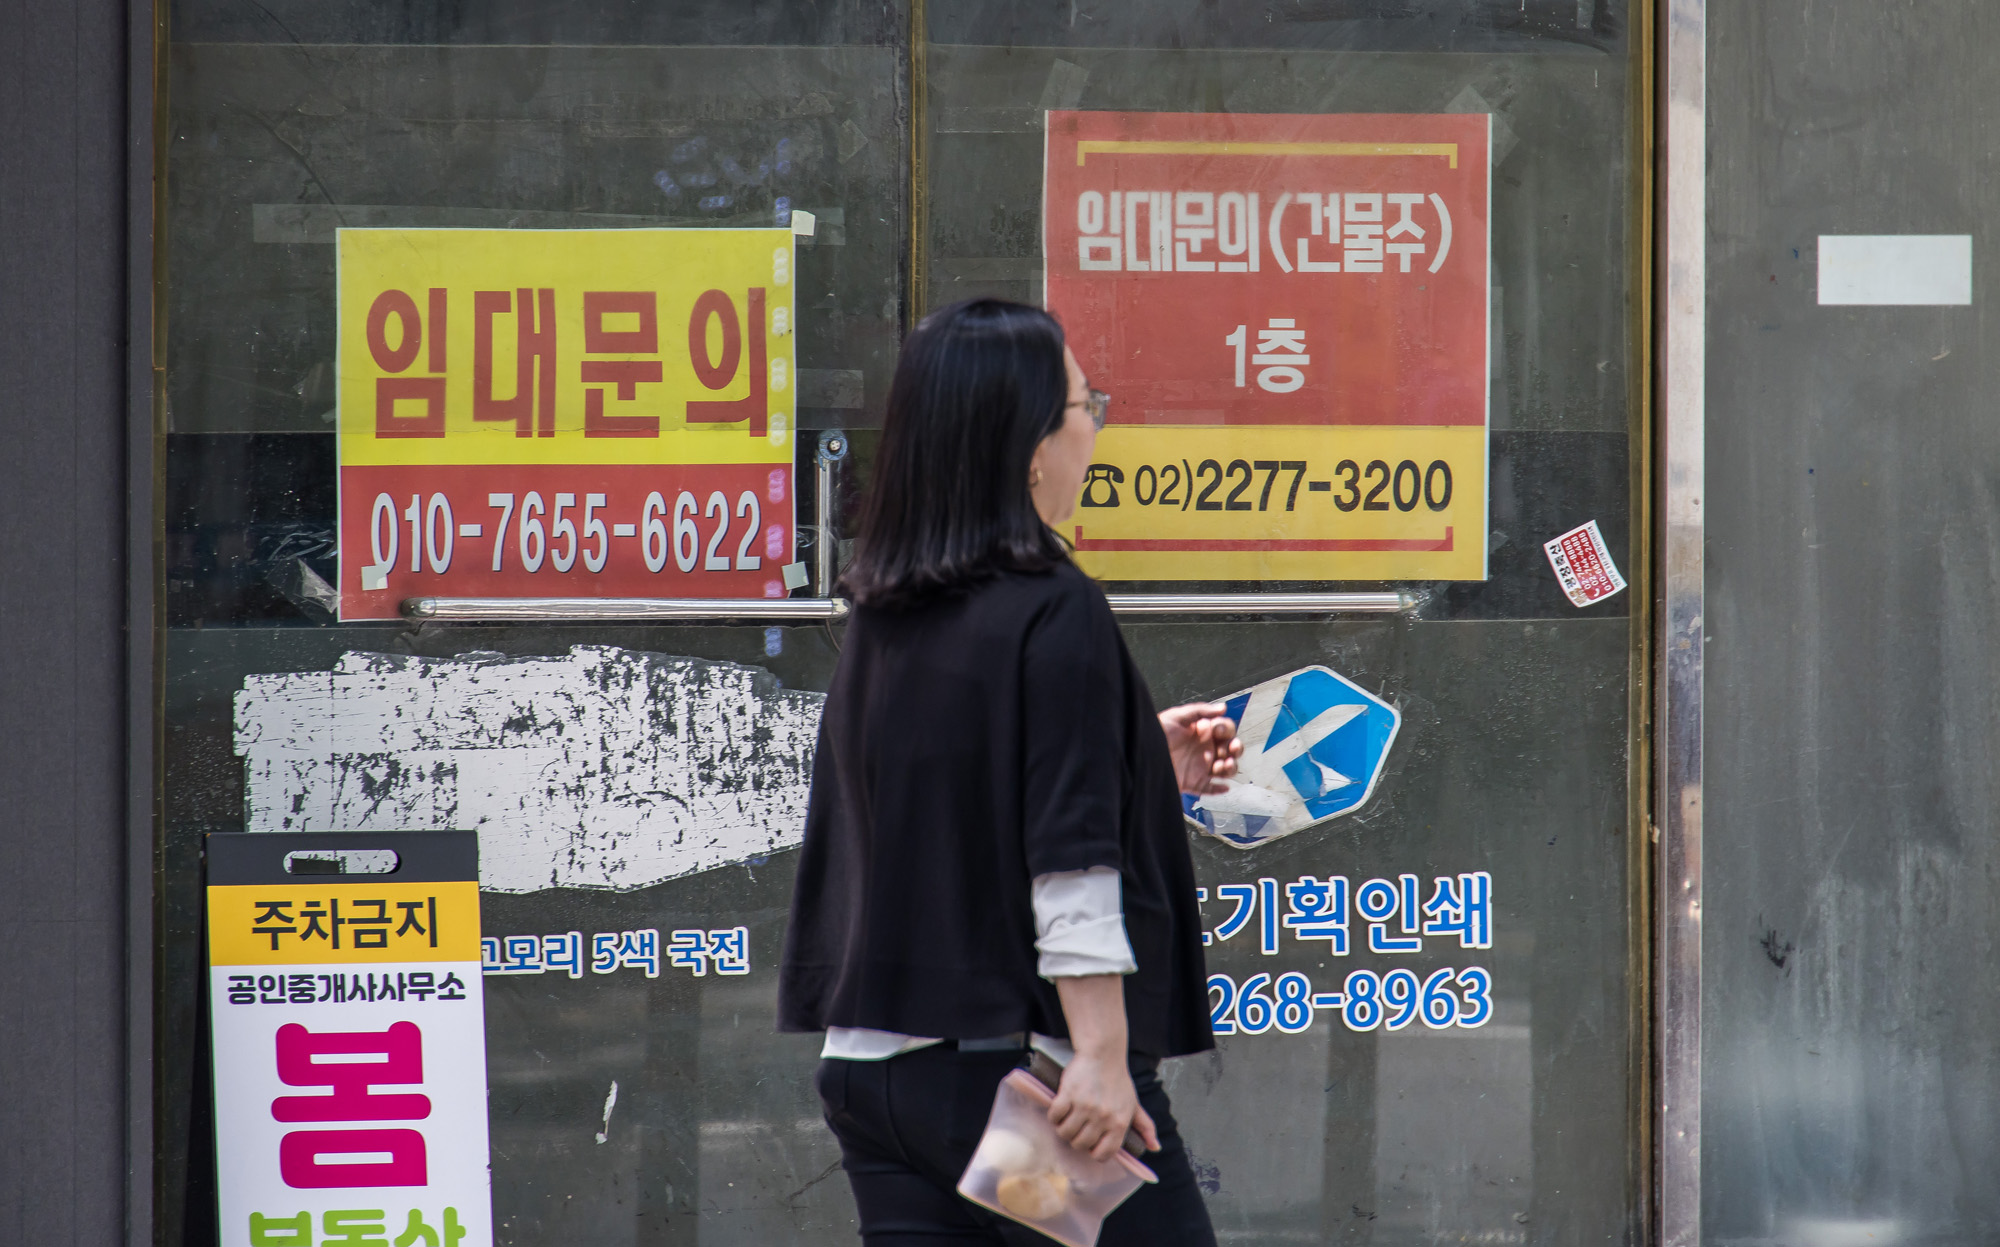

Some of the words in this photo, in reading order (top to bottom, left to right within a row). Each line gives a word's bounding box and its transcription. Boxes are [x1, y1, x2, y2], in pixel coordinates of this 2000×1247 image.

[1077, 190, 1453, 275] 임대문의(건물주)
[366, 287, 768, 438] 임대문의
[1225, 318, 1310, 394] 1층
[1134, 458, 1453, 512] 02)2277-3200
[371, 490, 762, 574] 010-7655-6622
[252, 896, 438, 951] 주차금지
[592, 929, 659, 978] 5색
[667, 926, 750, 977] 국전
[1196, 872, 1493, 956] 기획인쇄
[227, 972, 467, 1004] 공인중개사사무소
[270, 1021, 432, 1190] 봄
